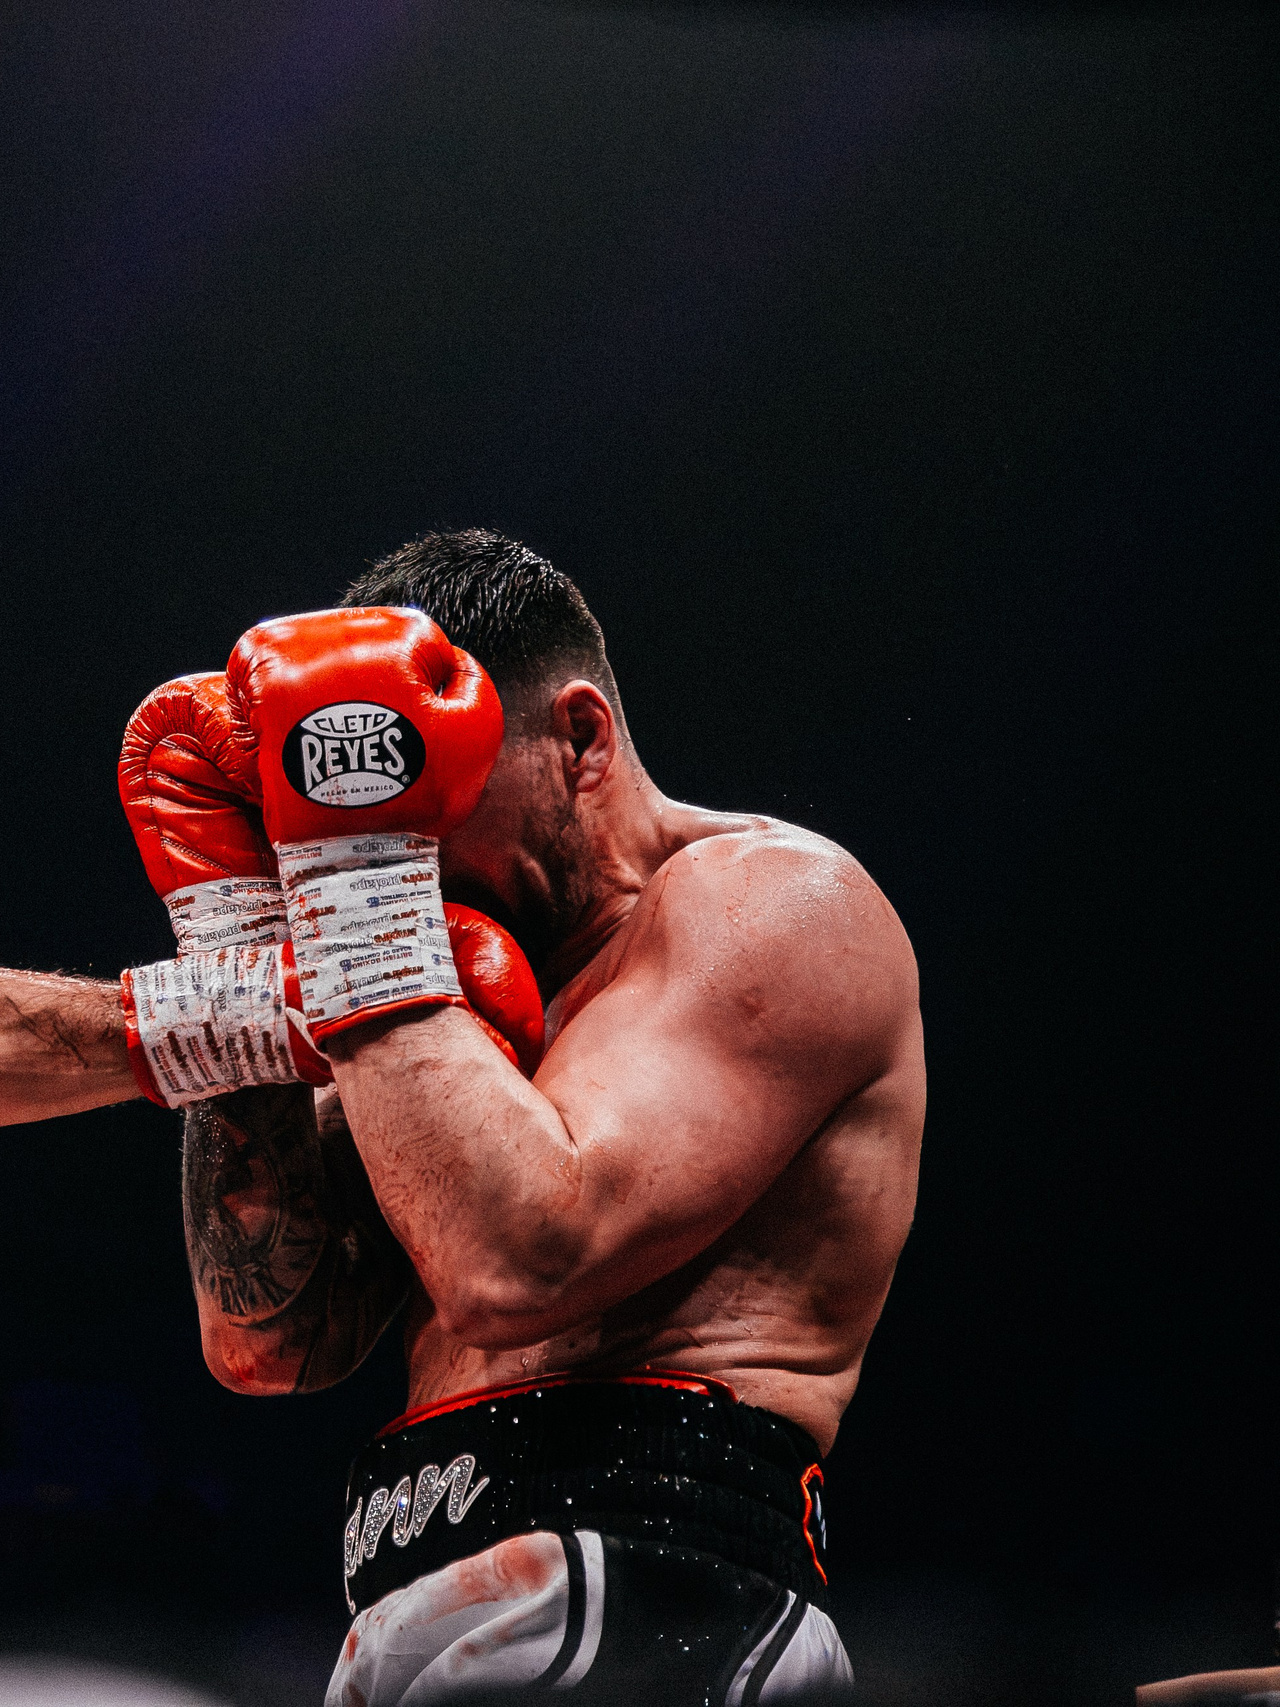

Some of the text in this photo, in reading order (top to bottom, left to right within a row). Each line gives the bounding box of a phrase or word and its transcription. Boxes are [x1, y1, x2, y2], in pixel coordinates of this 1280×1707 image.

[312, 712, 388, 735] CLETO
[301, 727, 405, 793] REYES
[344, 1453, 490, 1582] ann
